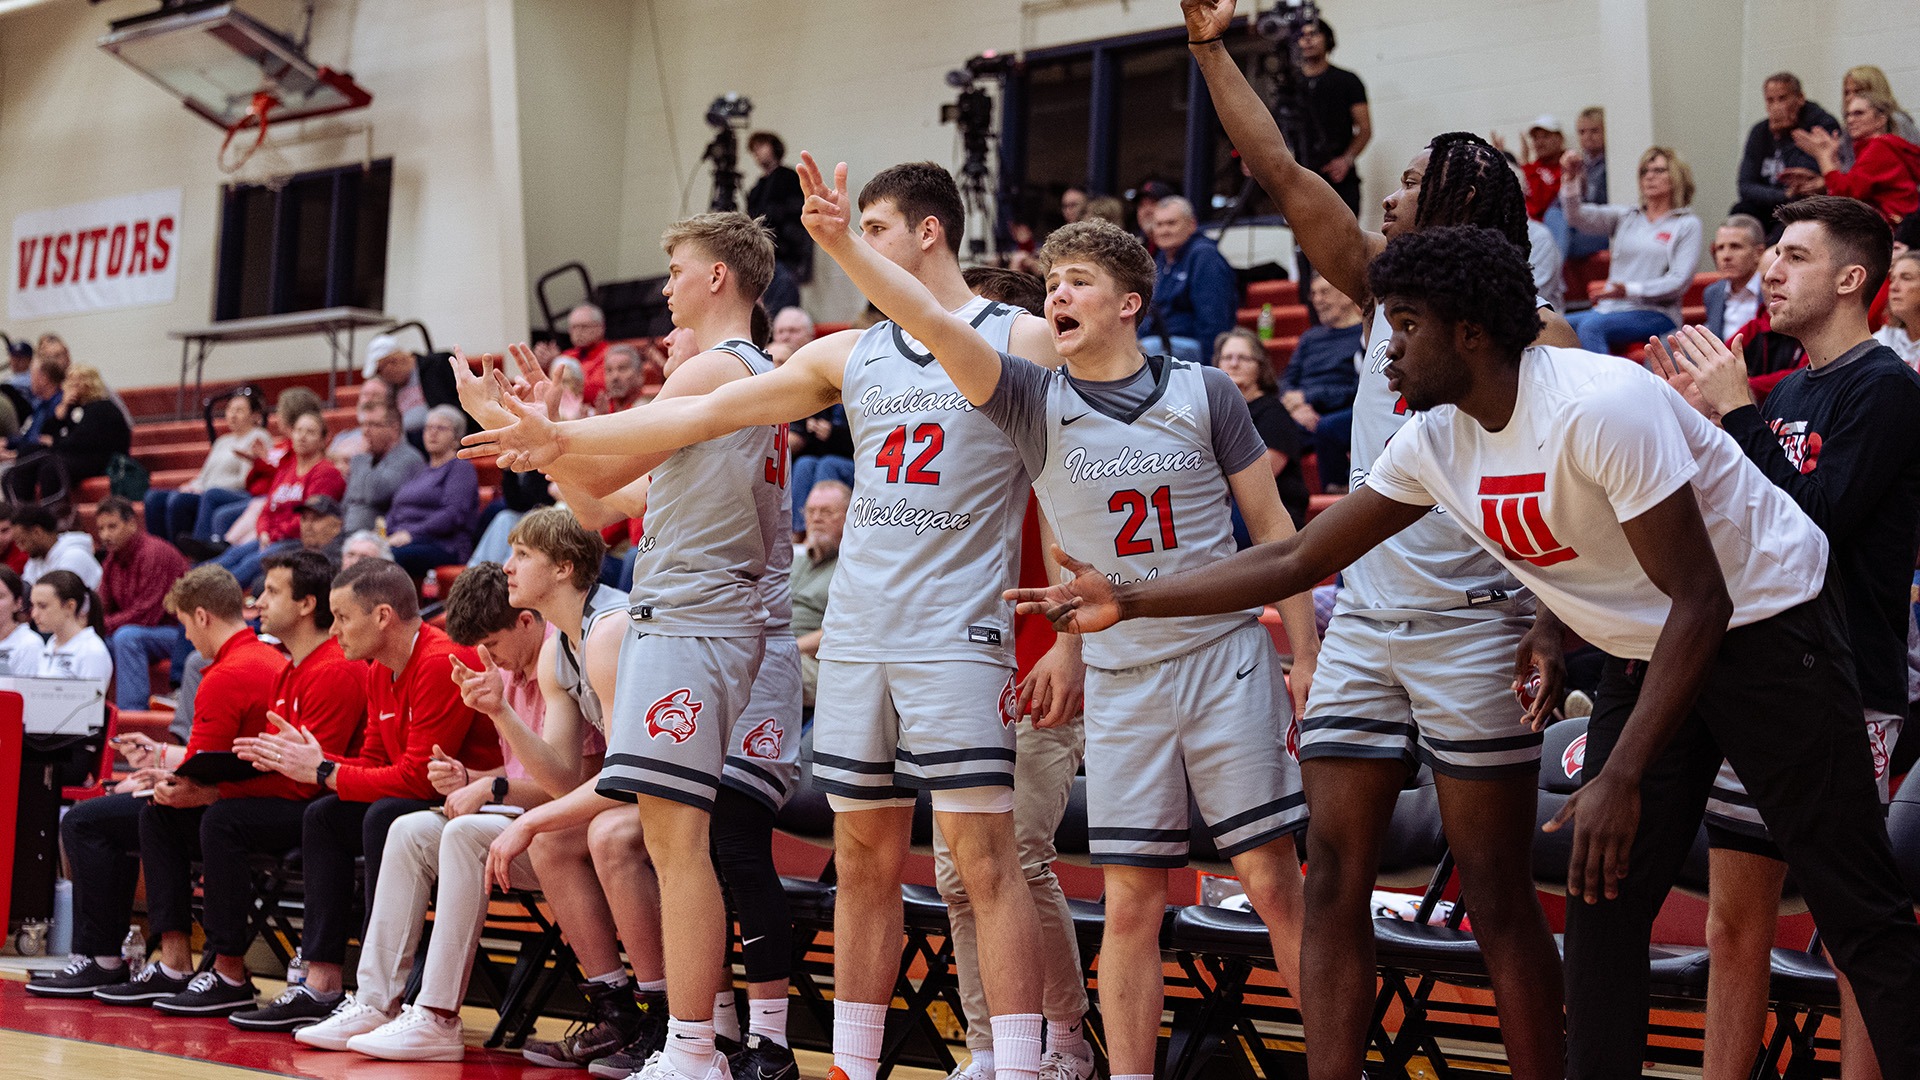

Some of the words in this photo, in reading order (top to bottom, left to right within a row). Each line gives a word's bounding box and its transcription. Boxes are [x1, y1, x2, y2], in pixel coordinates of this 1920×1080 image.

[18, 216, 175, 290] VISITORS
[861, 384, 976, 417] Indiana
[874, 422, 946, 486] 42
[1064, 446, 1204, 484] Indiana
[853, 496, 971, 536] Wesleyan
[1107, 485, 1179, 558] 21
